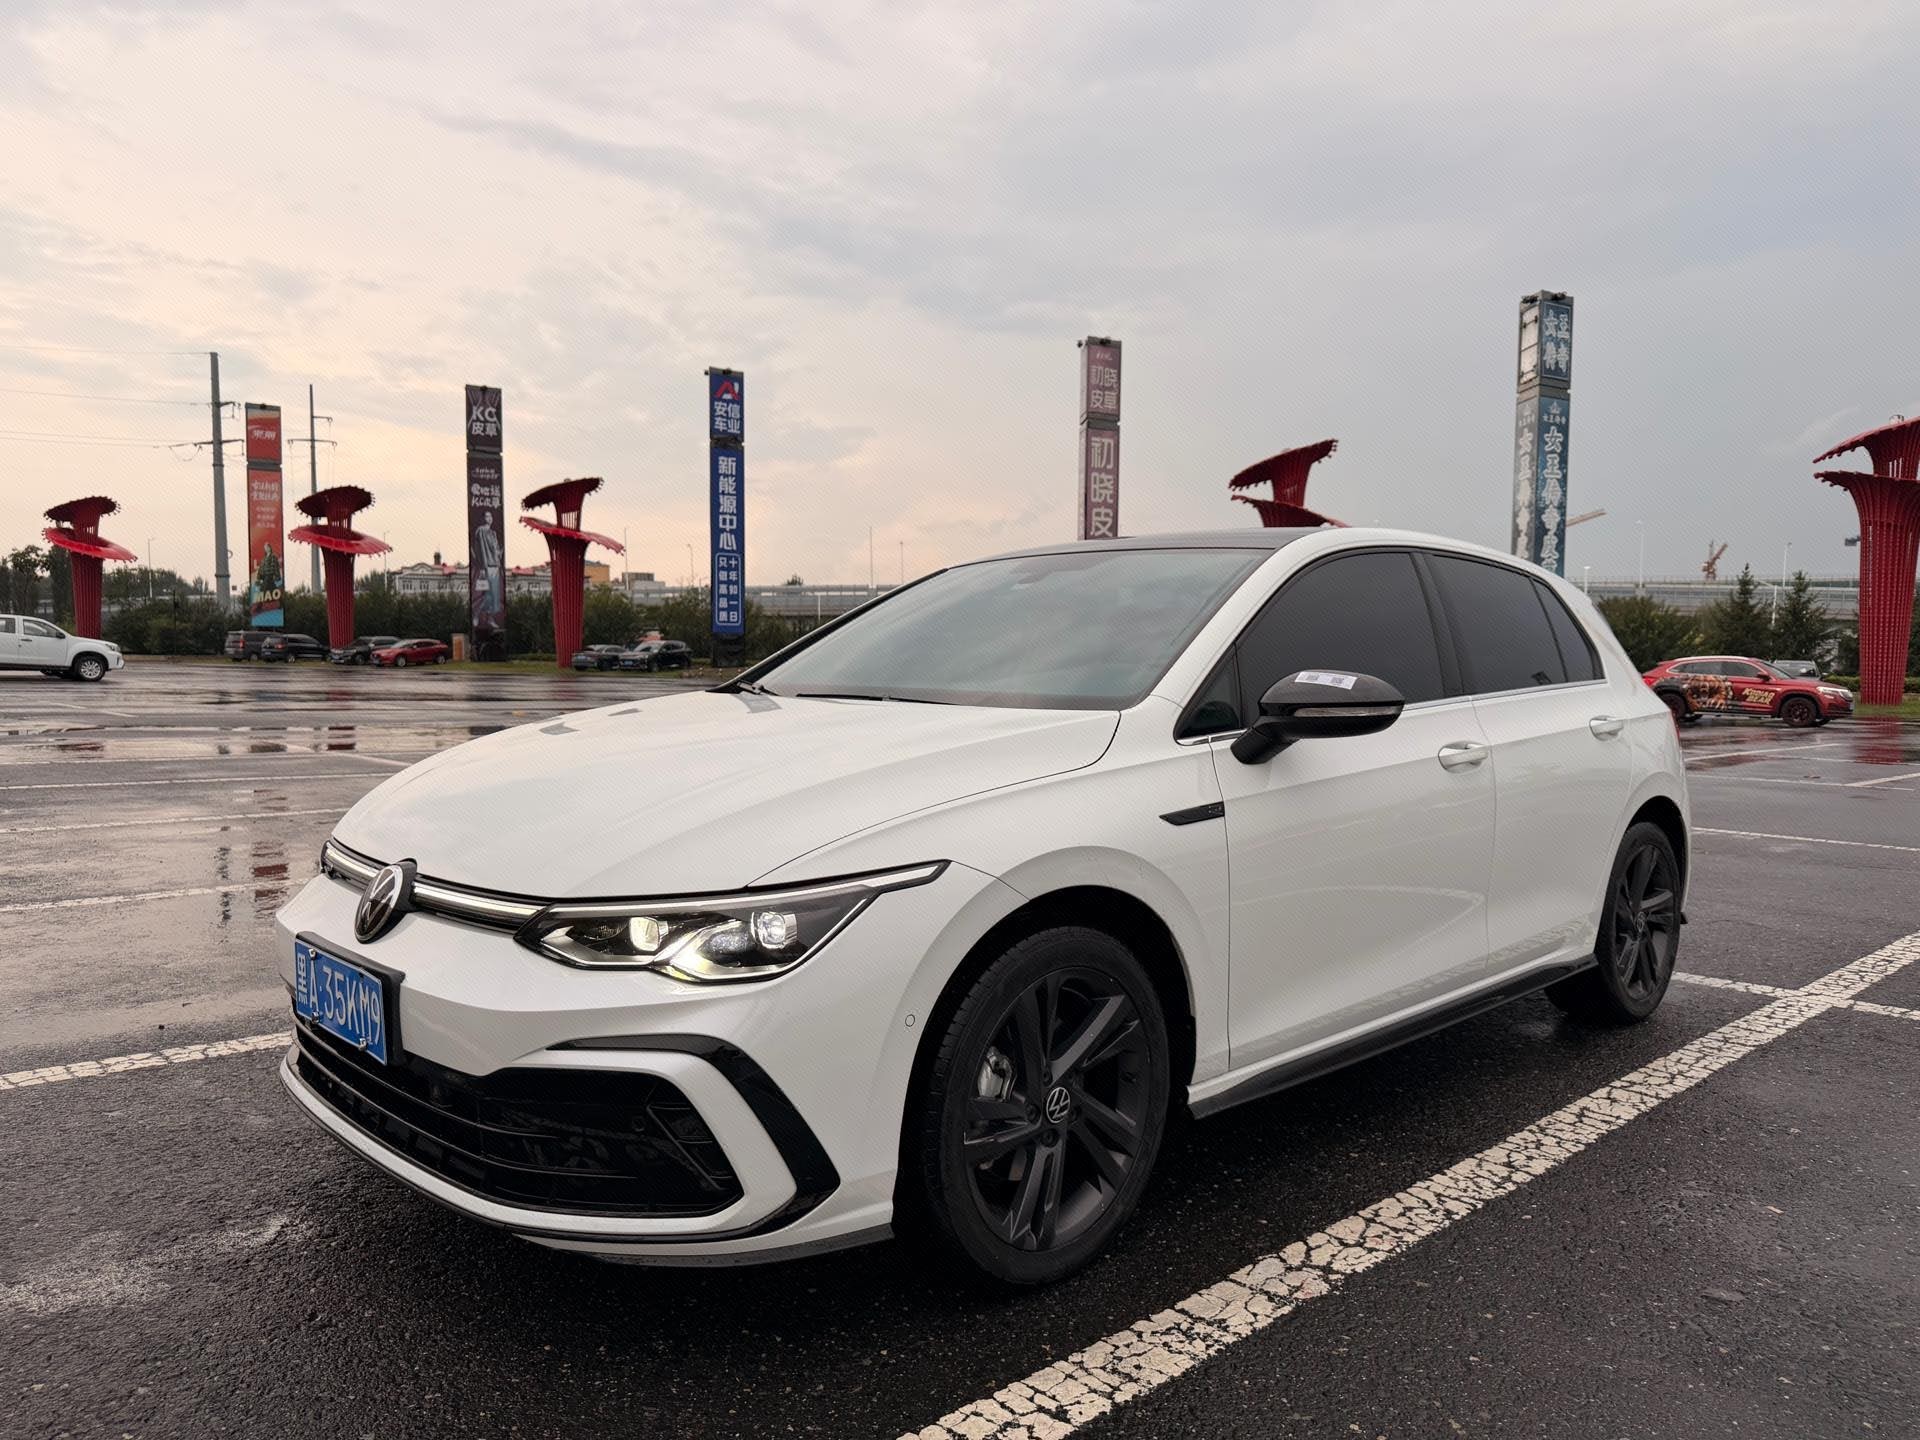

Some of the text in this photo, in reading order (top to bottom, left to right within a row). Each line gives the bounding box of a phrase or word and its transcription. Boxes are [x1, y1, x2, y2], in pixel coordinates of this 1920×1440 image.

[1090, 390, 1118, 409] 皮草
[472, 406, 497, 421] KC
[714, 401, 740, 419] 安信
[472, 422, 497, 437] 皮草
[714, 417, 740, 434] 车业
[718, 456, 737, 551] 新能源中心
[728, 557, 738, 621] 十年如一日
